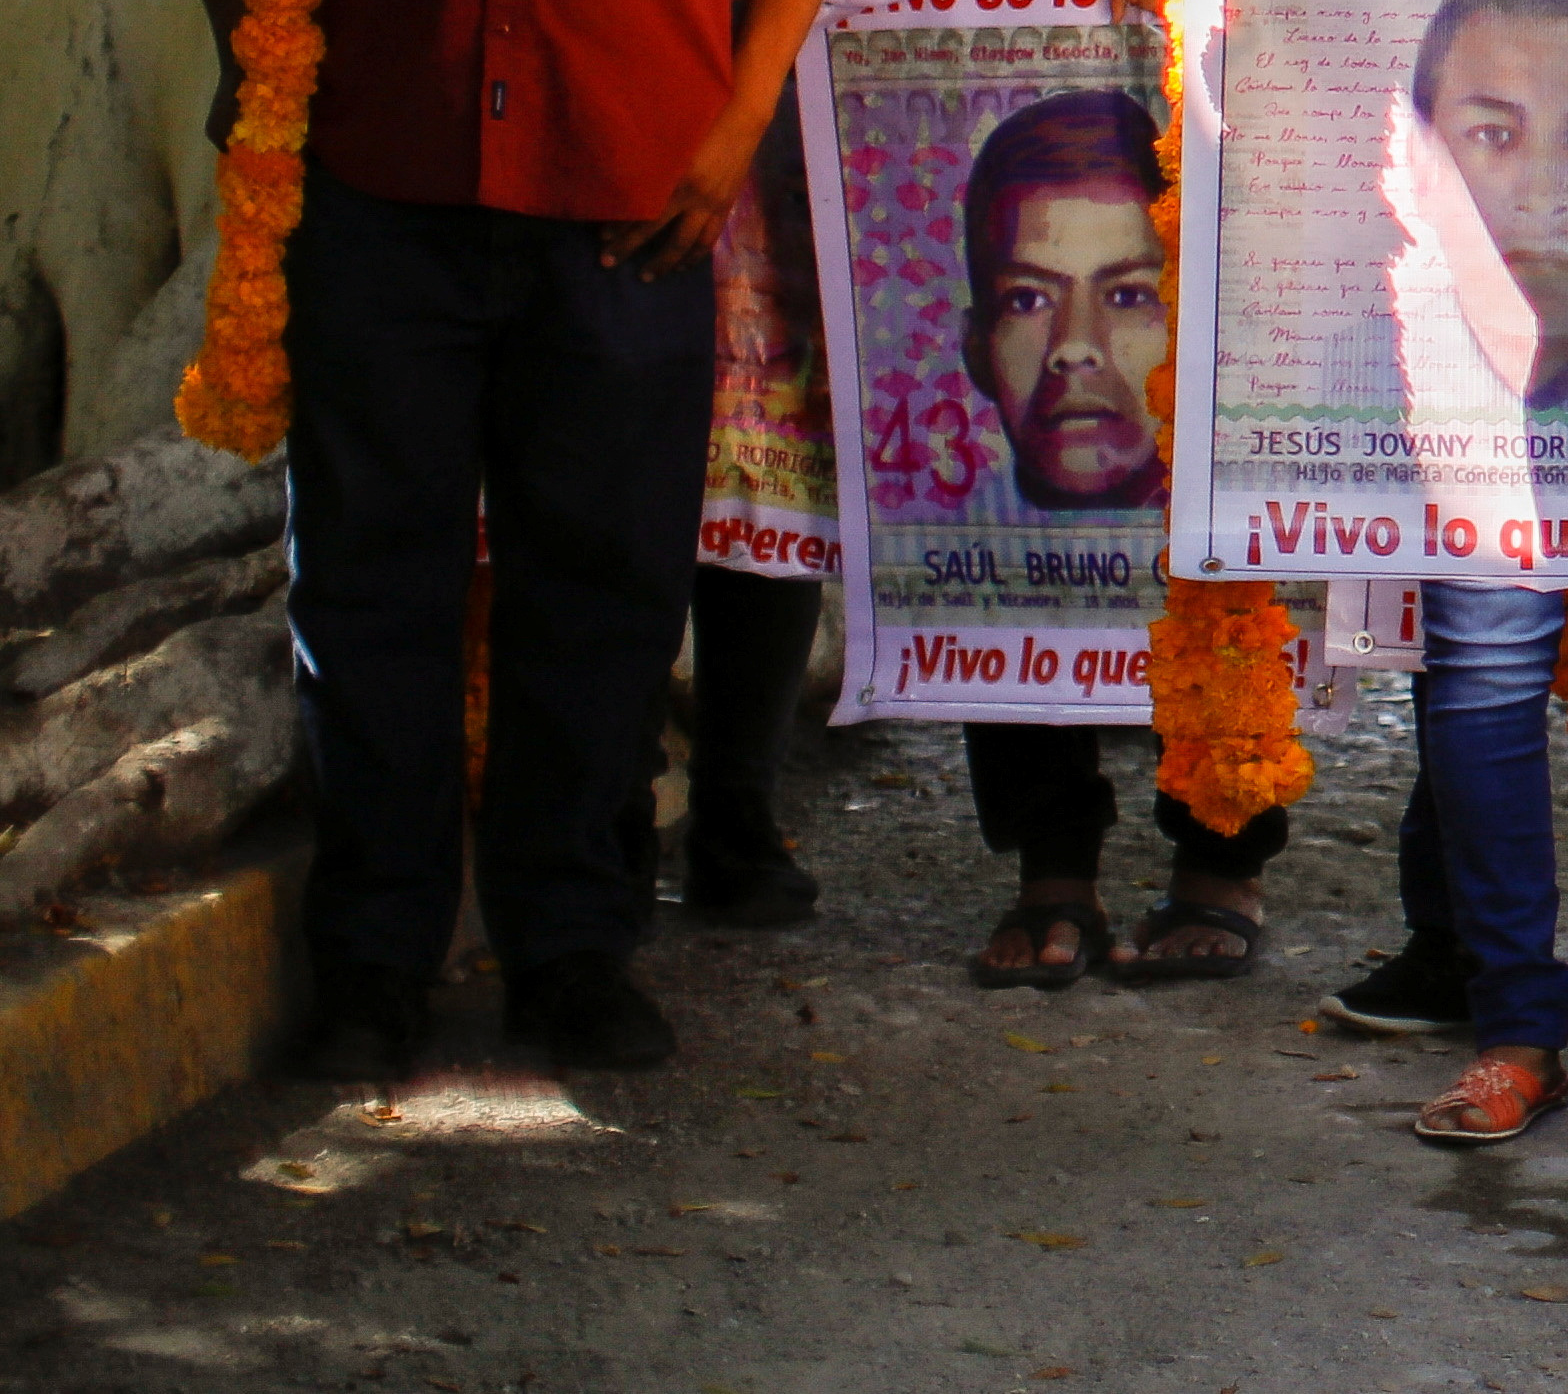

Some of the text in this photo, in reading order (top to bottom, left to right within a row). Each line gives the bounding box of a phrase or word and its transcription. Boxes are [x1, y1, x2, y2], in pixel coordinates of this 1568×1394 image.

[1043, 45, 1118, 61] Escocia,
[872, 397, 978, 497] 43
[1250, 427, 1341, 457] JESÚS
[1362, 434, 1471, 458] JOVANY
[1296, 465, 1342, 485] Hijo
[1352, 465, 1376, 483] de
[1386, 465, 1442, 483] María
[1453, 465, 1565, 487] Concepción
[1247, 500, 1401, 565] ¡Vivo
[1424, 503, 1479, 558] lo
[924, 543, 1131, 586] SAÚL BRUNO
[897, 633, 1058, 693] ¡Vivo lo
